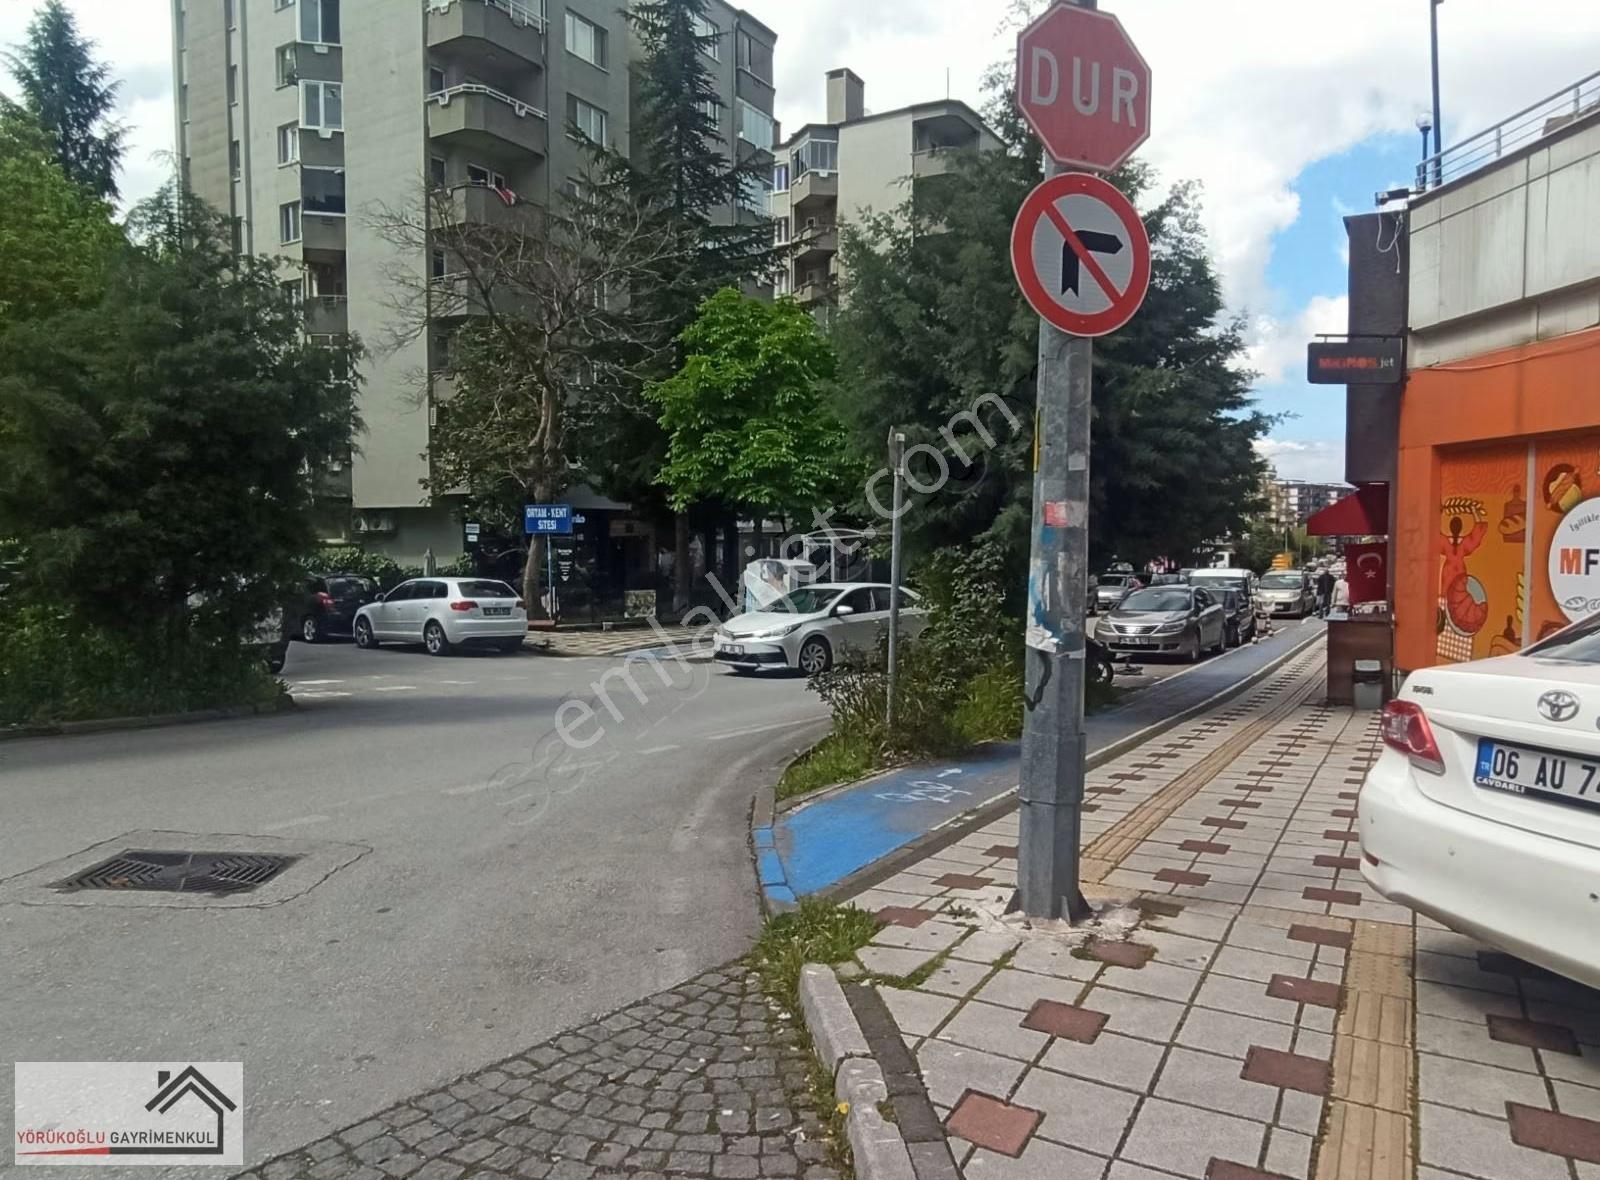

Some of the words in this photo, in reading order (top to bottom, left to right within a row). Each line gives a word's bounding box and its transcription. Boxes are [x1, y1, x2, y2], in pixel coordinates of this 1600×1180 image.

[1031, 47, 1139, 127] DUR
[1380, 357, 1395, 369] jet
[526, 507, 547, 518] ORTAM
[551, 507, 567, 518] KENT
[1492, 748, 1520, 779] 06
[1534, 757, 1566, 790] AU
[1577, 764, 1600, 796] 7
